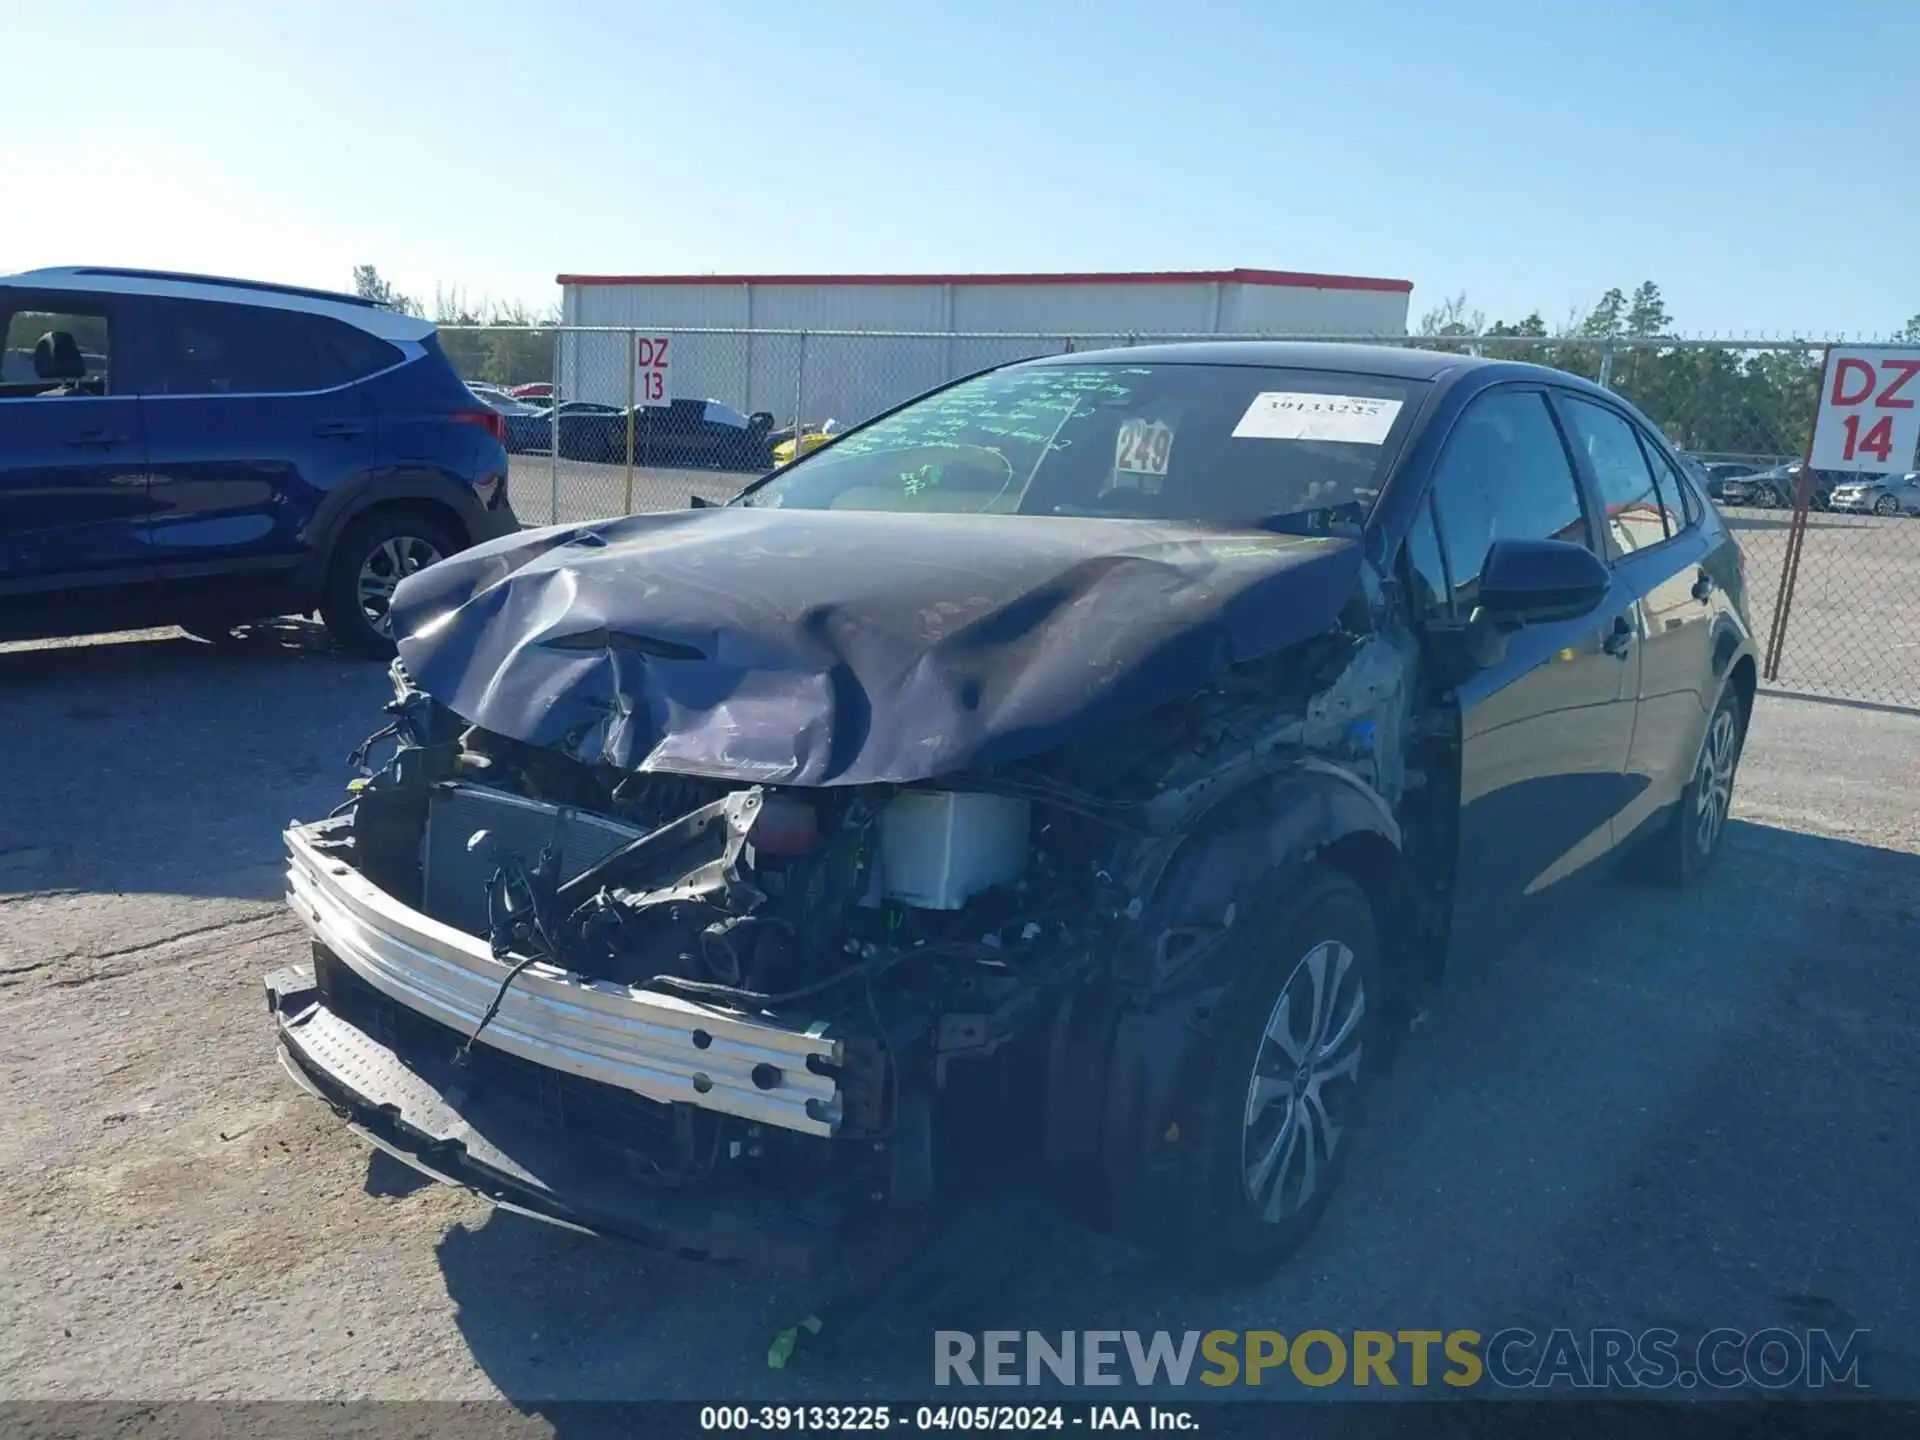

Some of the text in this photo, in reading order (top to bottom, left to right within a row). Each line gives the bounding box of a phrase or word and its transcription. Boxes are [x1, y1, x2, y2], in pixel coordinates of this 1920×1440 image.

[638, 337, 669, 368] DZ
[644, 371, 664, 400] 13
[1831, 357, 1920, 409] DZ
[1842, 414, 1894, 462] 14
